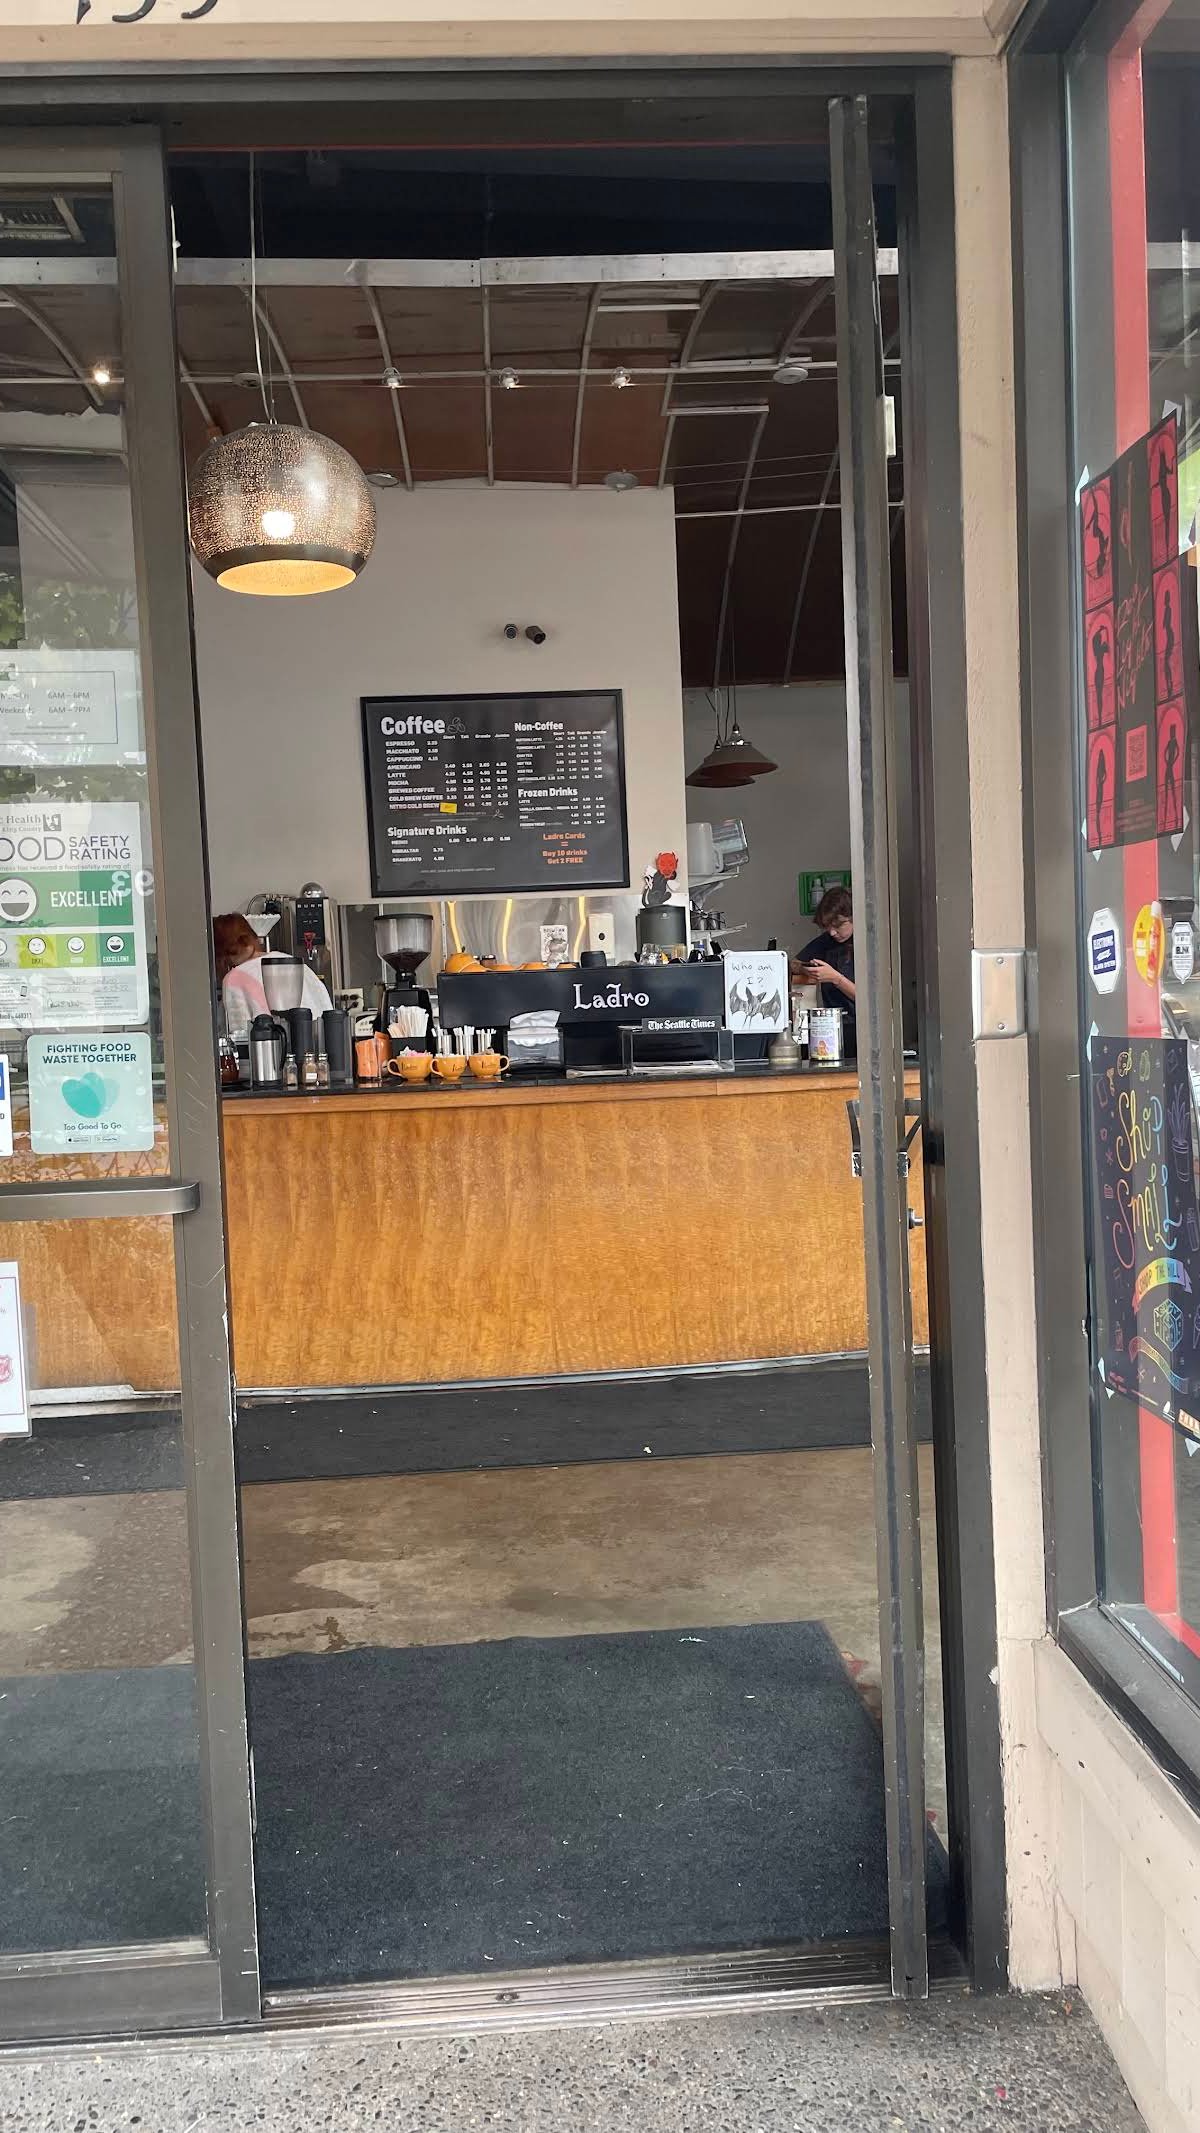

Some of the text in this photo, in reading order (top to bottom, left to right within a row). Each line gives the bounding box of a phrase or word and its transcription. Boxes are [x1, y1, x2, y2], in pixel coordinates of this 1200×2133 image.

[381, 715, 446, 735] Coffee
[514, 721, 564, 732] Non-Coffee
[518, 787, 578, 798] Frozen Drinks
[6, 815, 42, 824] Health
[387, 825, 467, 838] Signature Drinks
[543, 833, 564, 841] Ladro
[0, 835, 129, 861] OOD SAFETY
[565, 848, 588, 856] drinks
[70, 848, 131, 860] RATING
[50, 890, 124, 908] EXCELLENT
[103, 955, 130, 963] EXCELLENT
[731, 963, 753, 971] Who
[573, 983, 650, 1009] Ladro
[648, 1018, 716, 1031] The Seattle Times
[47, 1043, 131, 1053] FIGHTING FOOD
[42, 1053, 137, 1064] WASTE TOGETHER
[63, 1121, 122, 1131] Too Good To Go
